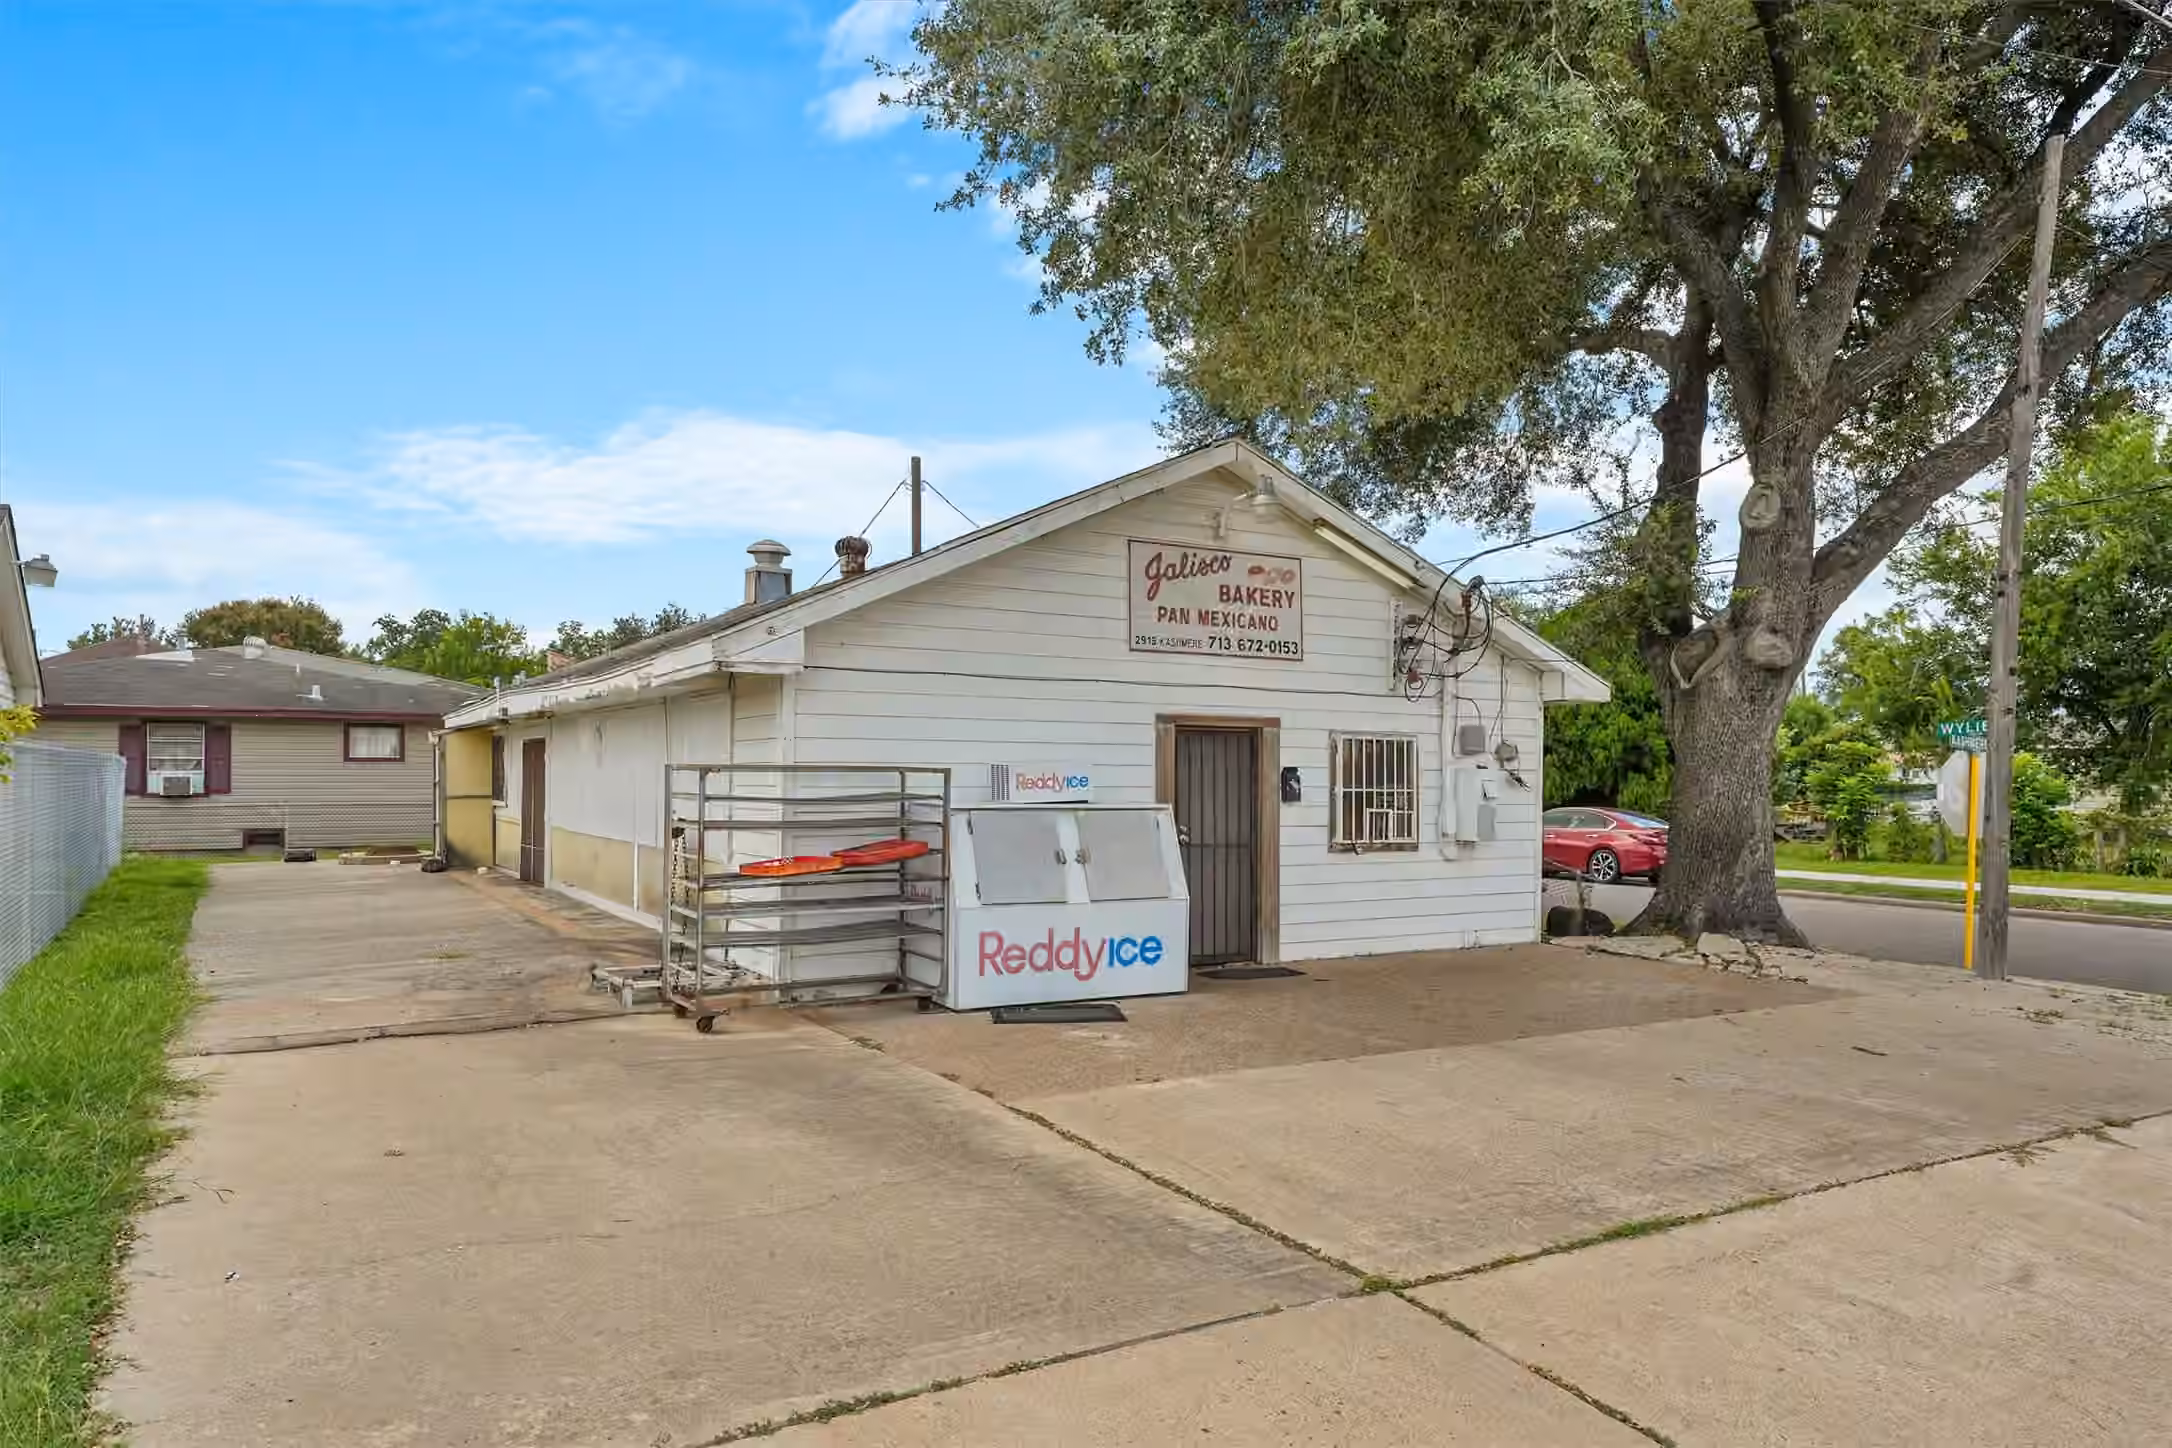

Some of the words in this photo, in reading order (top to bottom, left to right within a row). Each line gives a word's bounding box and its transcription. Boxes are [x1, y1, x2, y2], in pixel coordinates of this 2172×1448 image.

[1144, 551, 1232, 602] Jalisco
[1219, 584, 1295, 609] BAKERY
[1157, 606, 1190, 625] PAN
[1198, 610, 1279, 631] MEXICANO
[1135, 635, 1157, 646] 2915
[1208, 636, 1231, 650] 713
